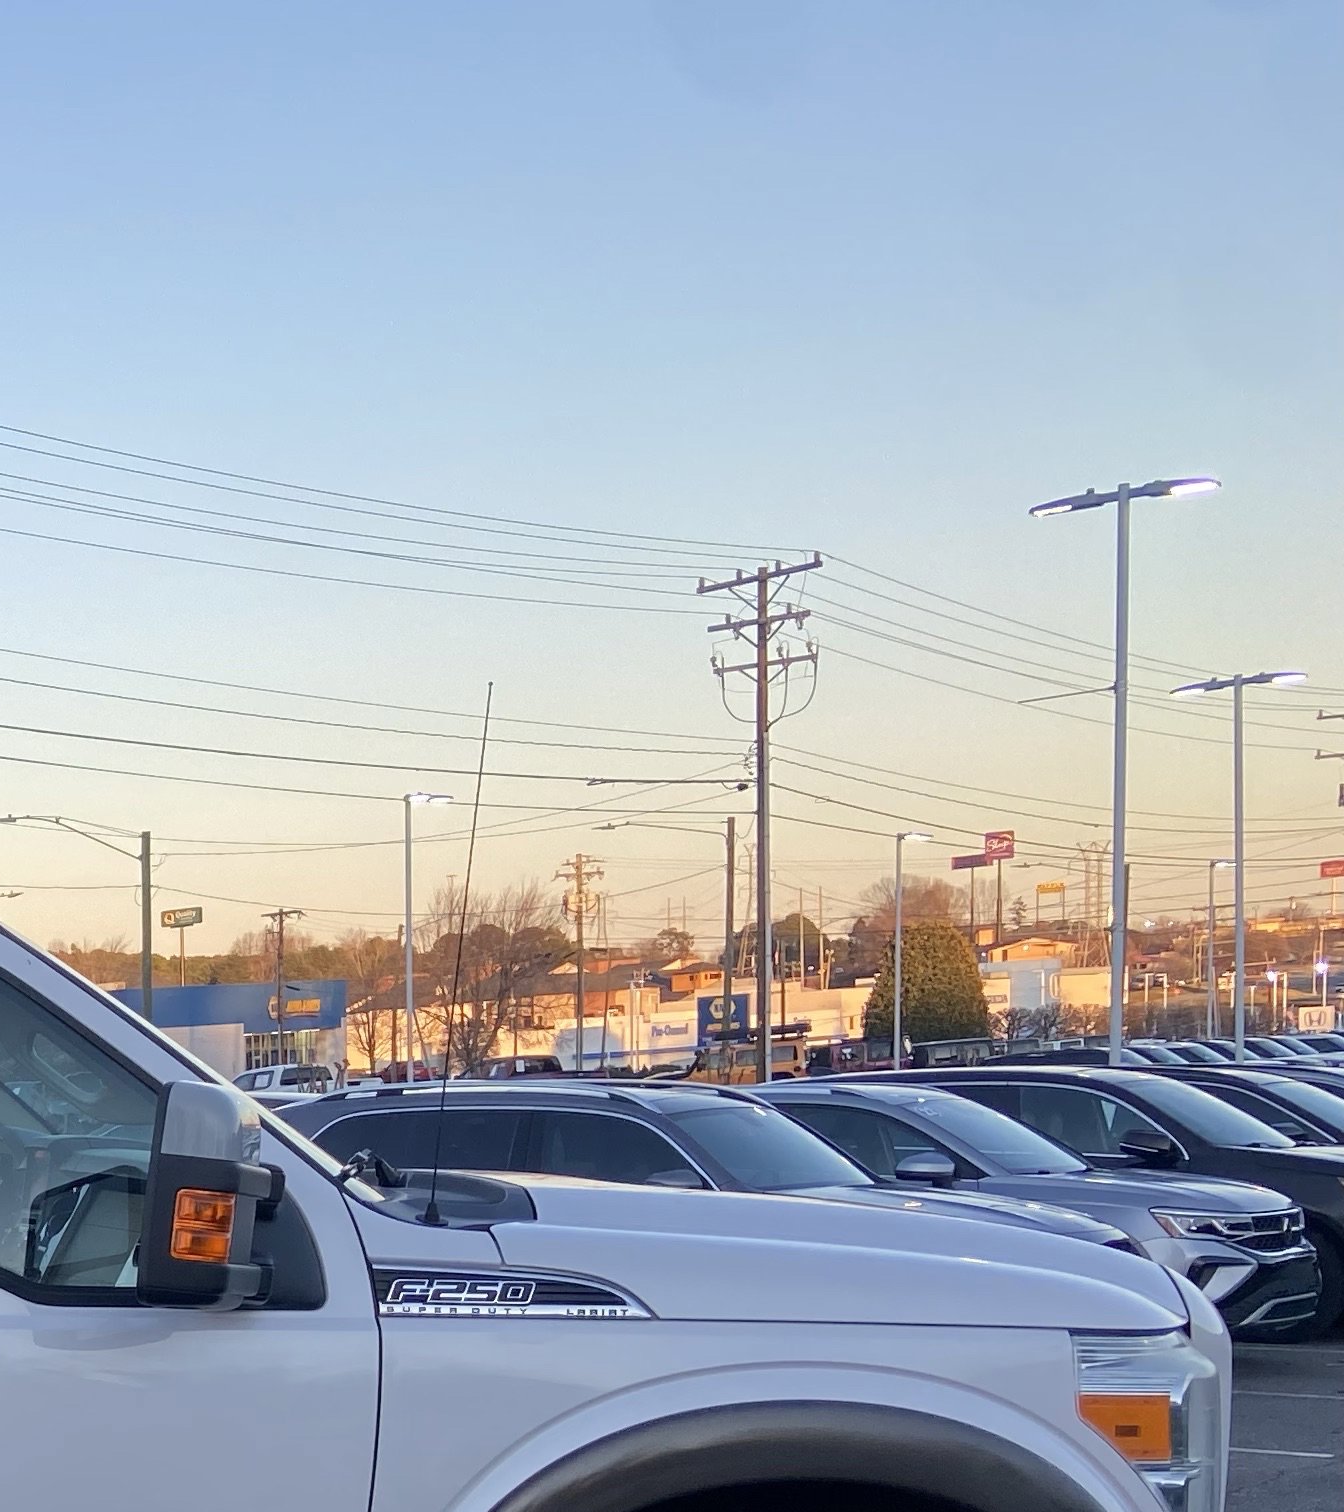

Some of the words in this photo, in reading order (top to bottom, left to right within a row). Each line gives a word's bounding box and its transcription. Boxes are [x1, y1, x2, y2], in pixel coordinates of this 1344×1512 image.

[387, 1279, 536, 1304] F-250
[386, 1306, 458, 1314] SUPER
[472, 1307, 529, 1315] DUTY
[566, 1308, 630, 1317] LARIAT
